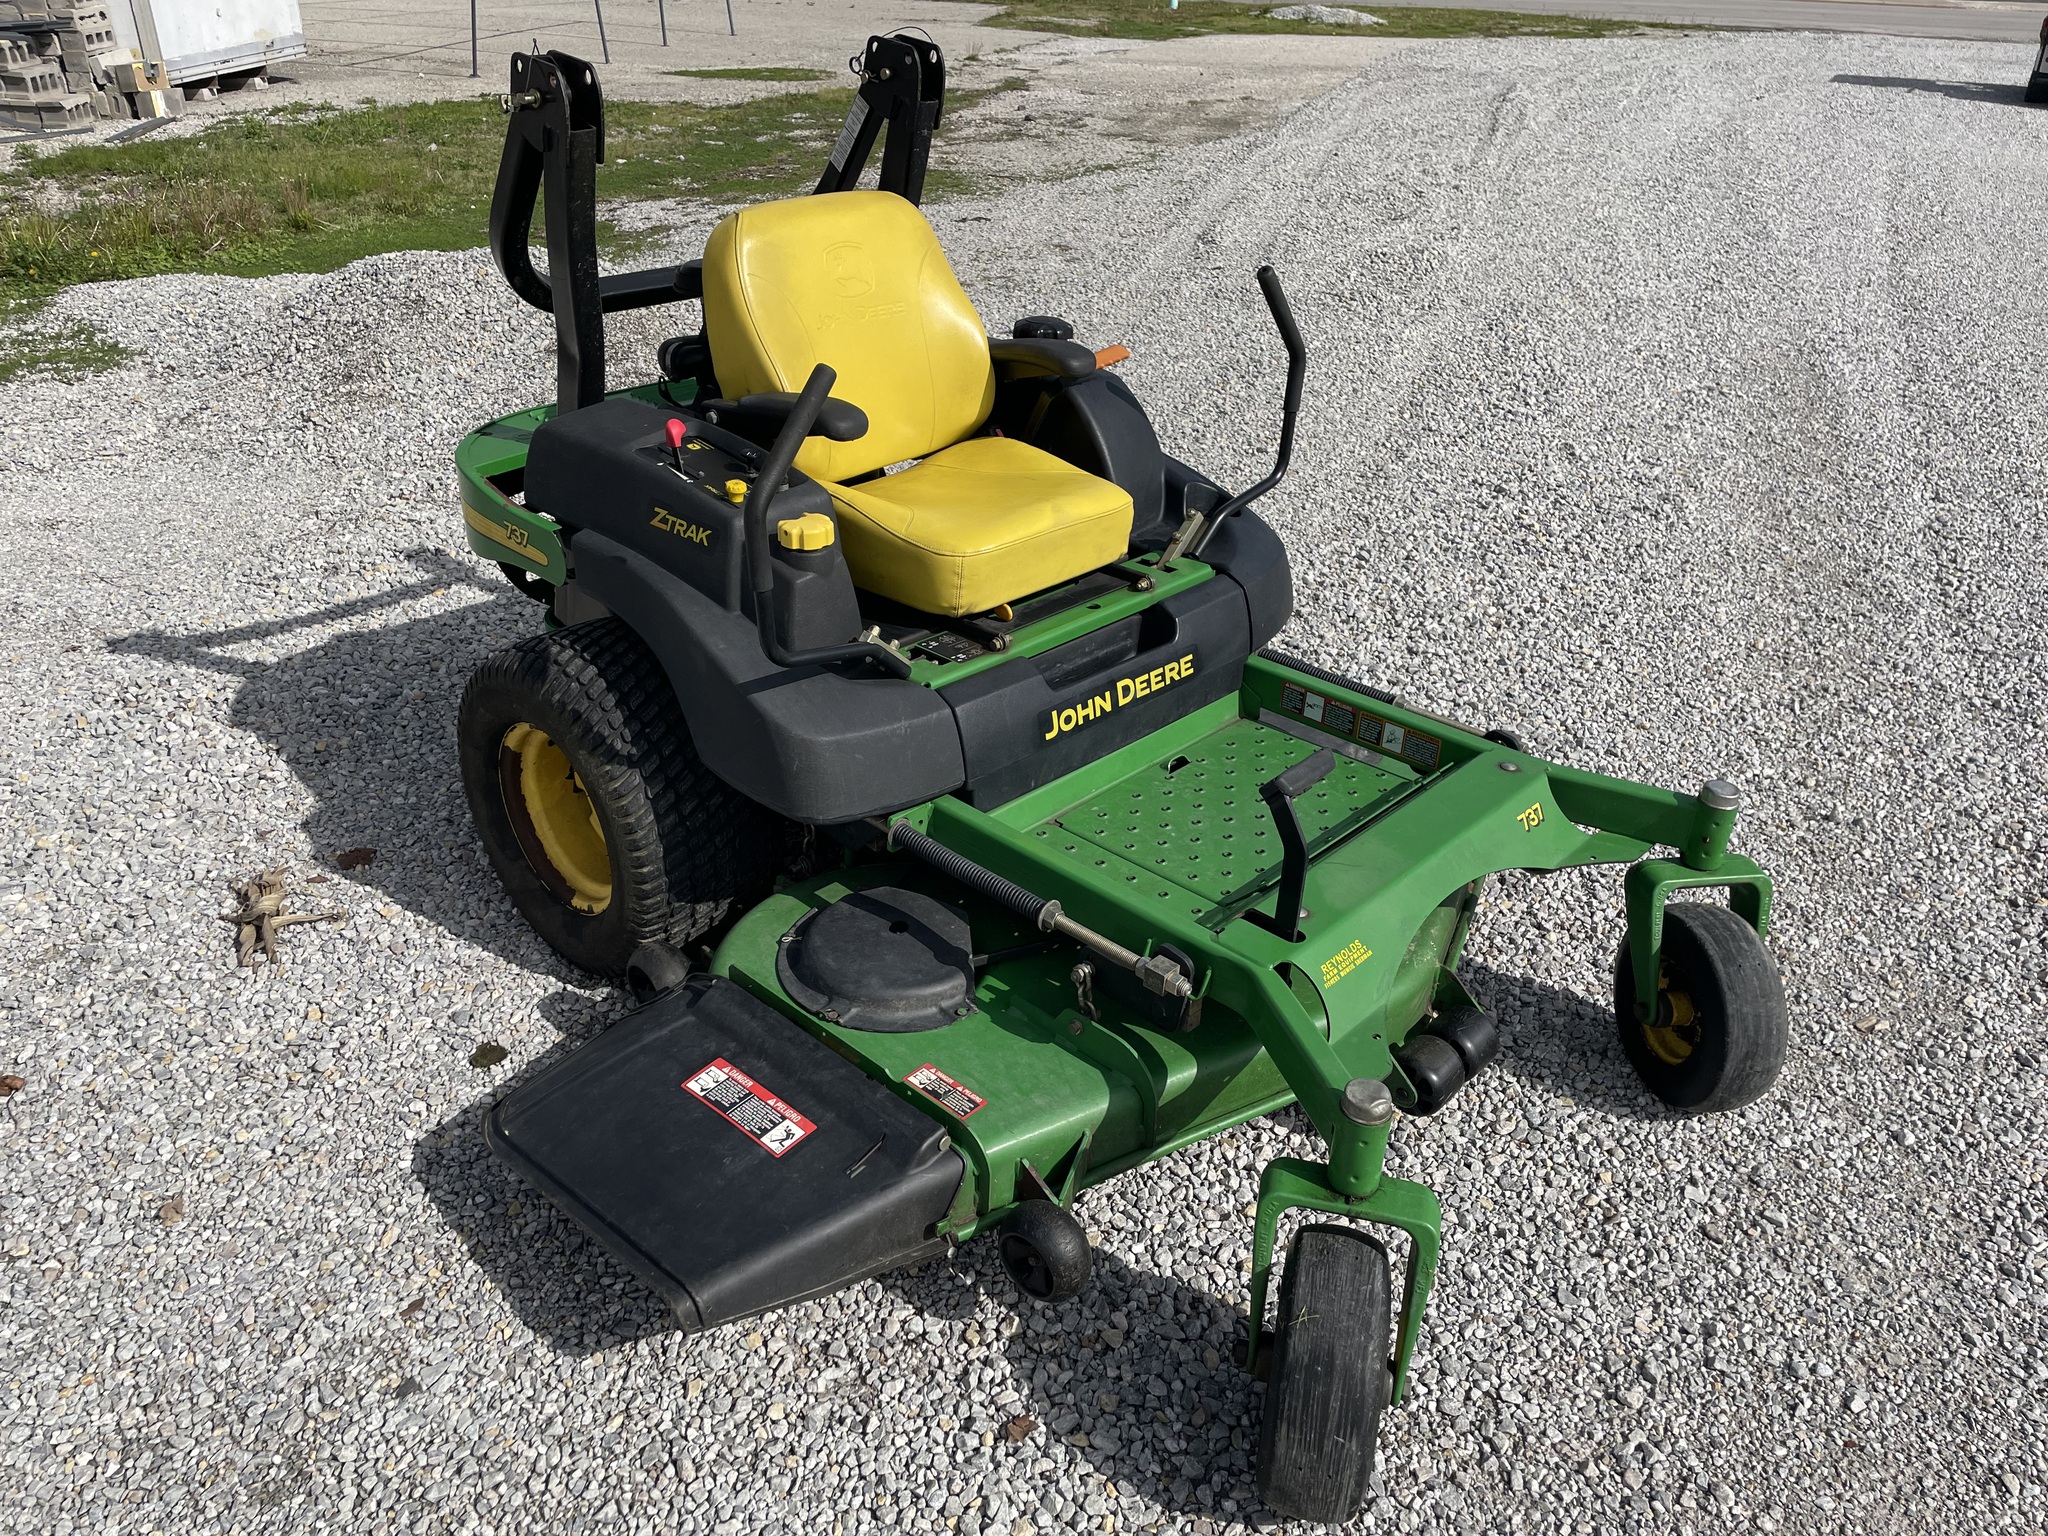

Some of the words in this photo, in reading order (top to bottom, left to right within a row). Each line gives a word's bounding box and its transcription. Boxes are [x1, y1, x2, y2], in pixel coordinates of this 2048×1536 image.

[855, 301, 906, 322] DEERE
[503, 520, 529, 548] 737
[1045, 691, 1112, 741] JOHN
[1116, 654, 1194, 707] DEERE
[1516, 802, 1545, 832] 737
[1320, 939, 1362, 974] REYNOLDS
[1323, 967, 1338, 982] FARM
[1337, 945, 1368, 970] EQUIPMENT
[728, 1069, 754, 1088] DANGER
[774, 1101, 801, 1122] PELIGRO
